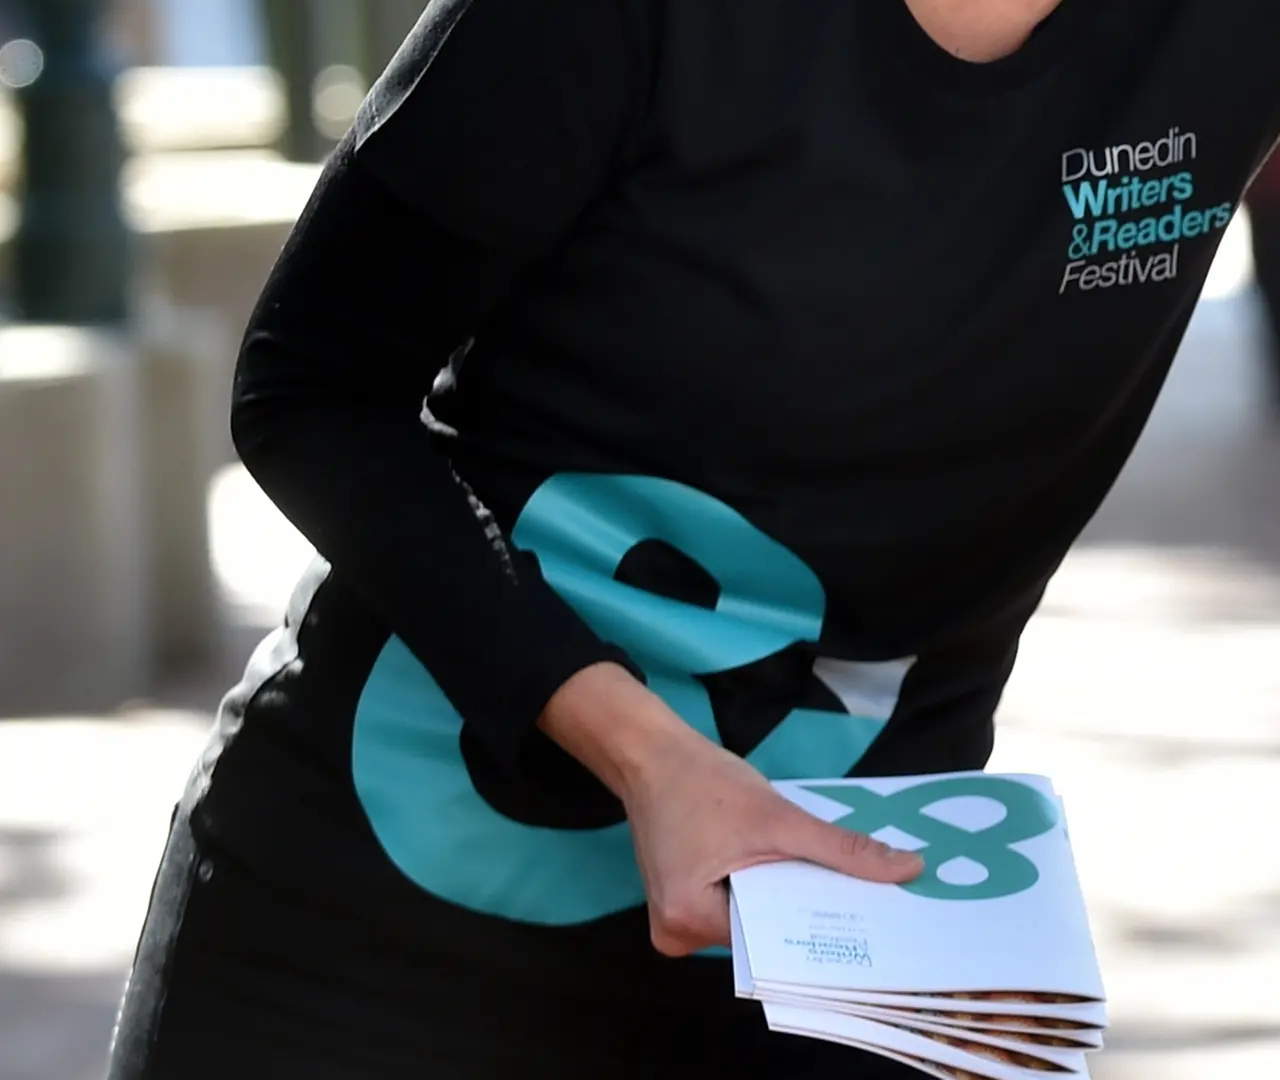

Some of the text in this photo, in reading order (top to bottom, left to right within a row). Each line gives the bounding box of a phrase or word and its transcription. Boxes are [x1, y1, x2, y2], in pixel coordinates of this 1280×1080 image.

[1061, 126, 1197, 183] Dunedin
[1062, 171, 1193, 220] Writers
[1068, 202, 1232, 260] &Readers
[1059, 243, 1180, 295] Festival
